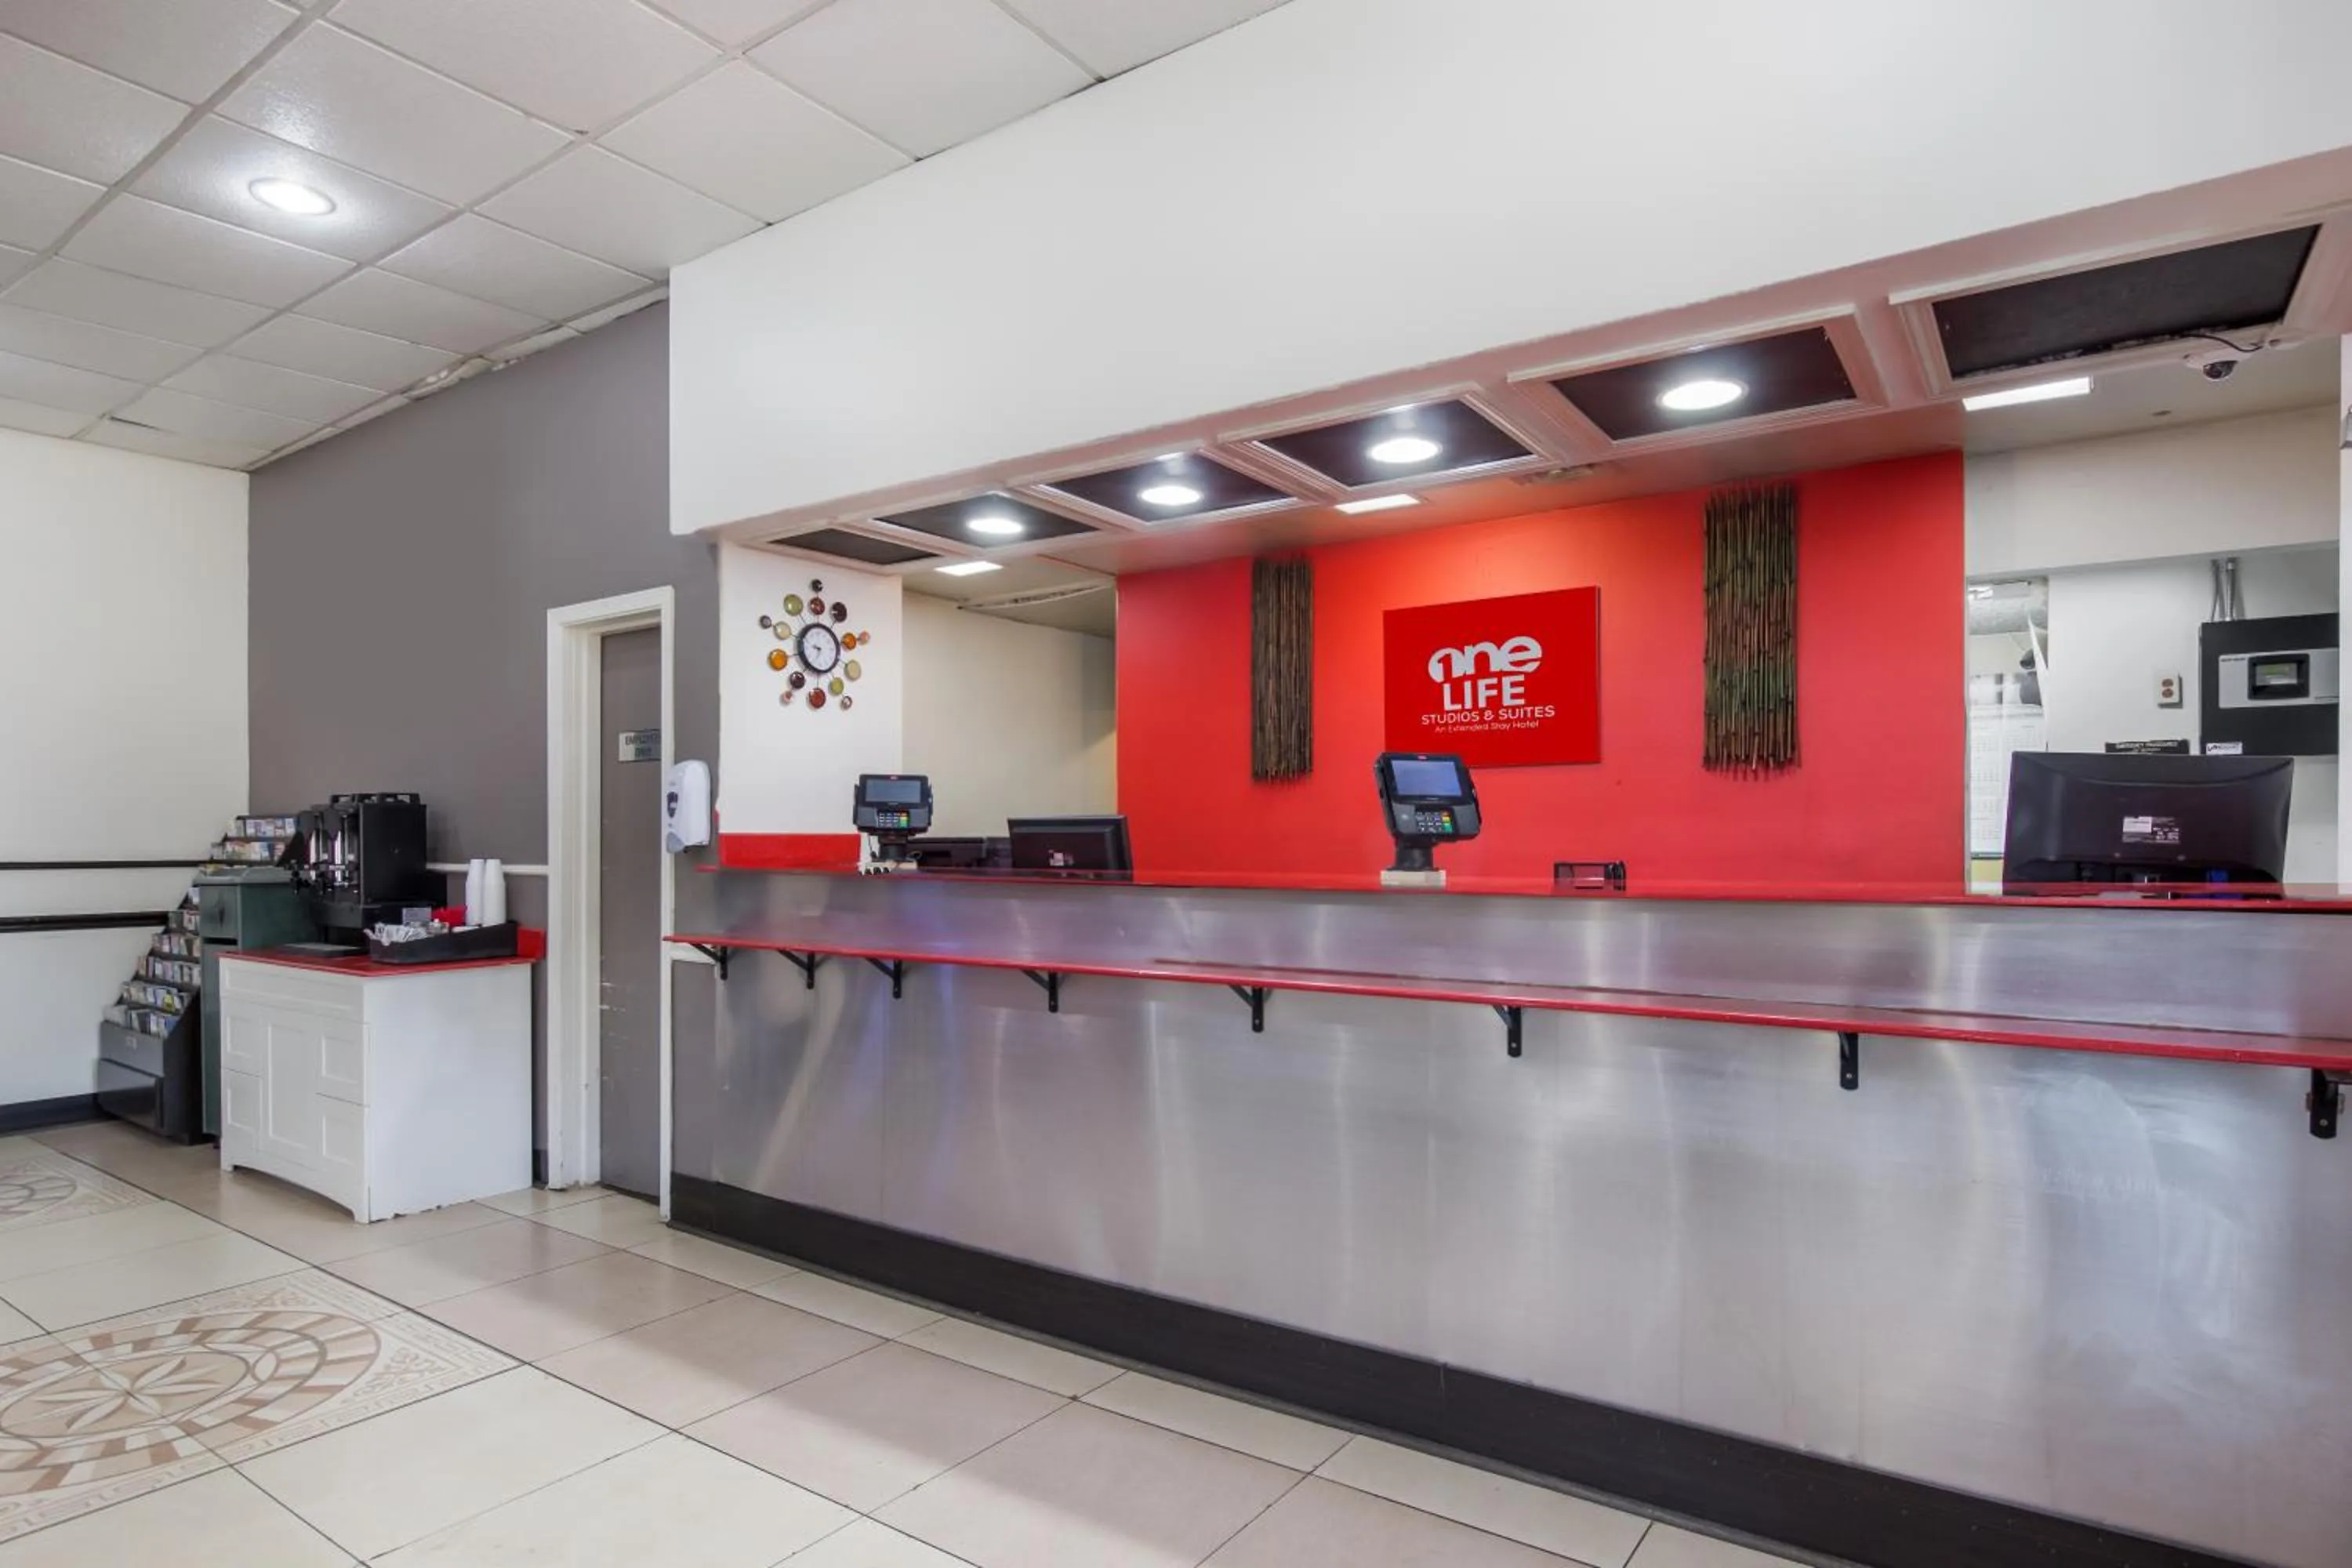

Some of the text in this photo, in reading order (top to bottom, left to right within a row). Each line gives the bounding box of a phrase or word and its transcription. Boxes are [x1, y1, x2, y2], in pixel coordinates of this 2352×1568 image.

[1428, 636, 1542, 683] one
[1443, 674, 1525, 711] LIFE
[1421, 705, 1555, 725] STUDIOS & SUITES
[1448, 722, 1489, 732] Extended
[1490, 720, 1511, 731] Stay
[1512, 719, 1539, 729] Hotel
